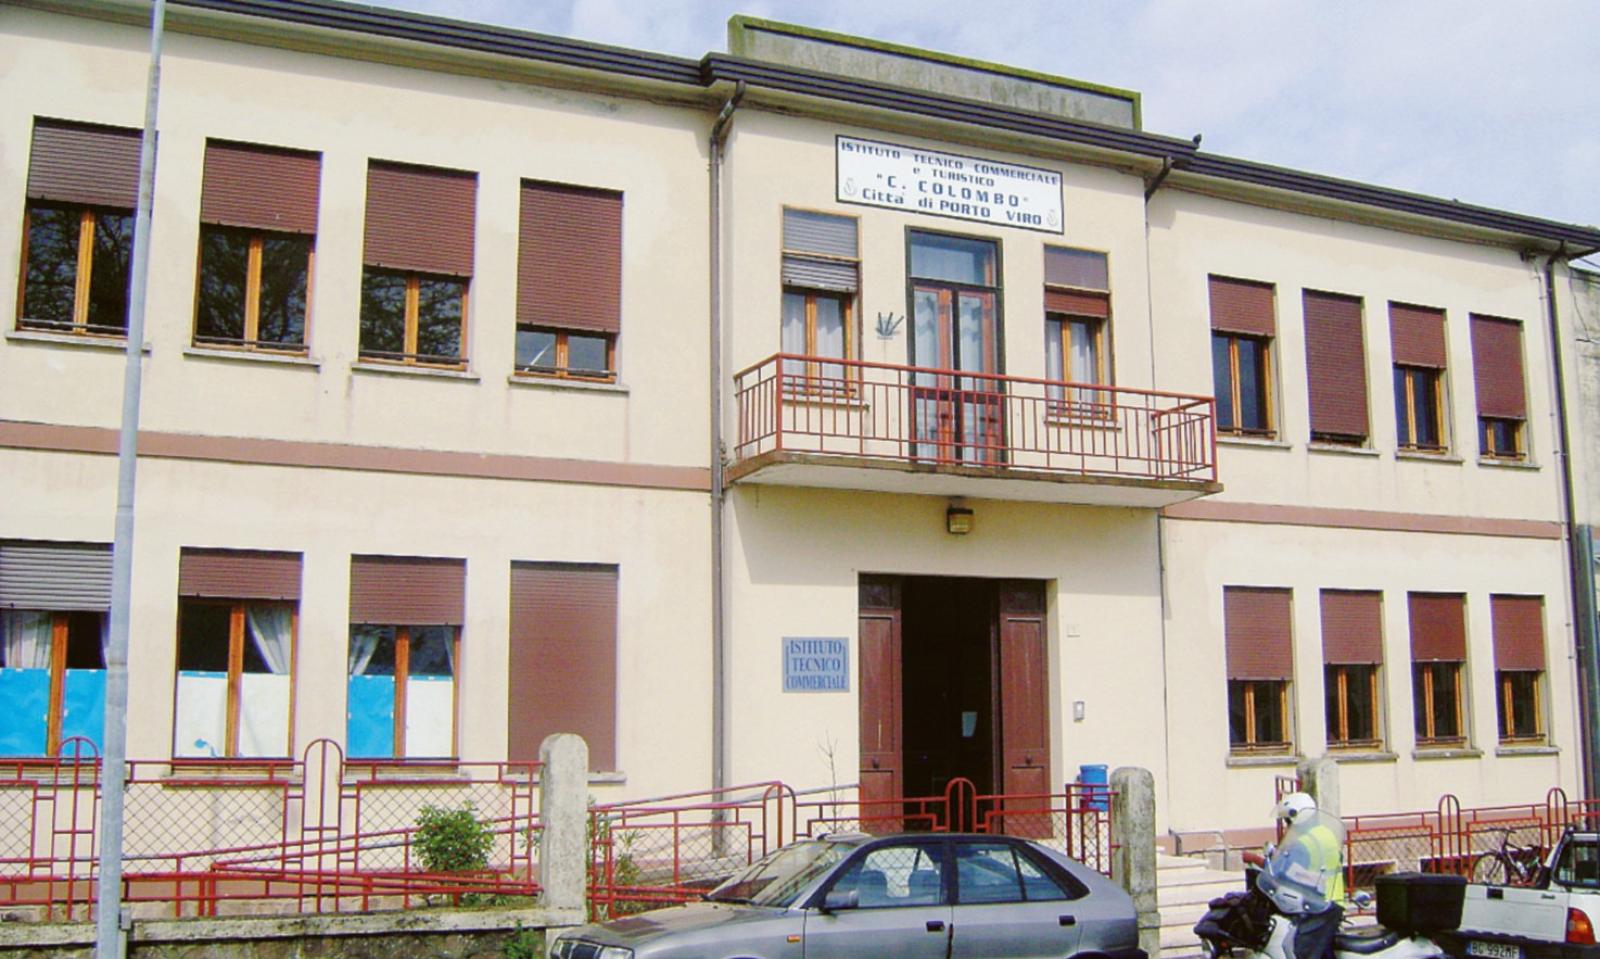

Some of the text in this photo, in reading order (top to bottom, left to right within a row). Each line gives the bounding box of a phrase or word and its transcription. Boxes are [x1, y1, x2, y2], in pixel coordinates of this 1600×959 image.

[841, 141, 1058, 186] ISTITUTO TECNICO COMMERCIALE
[932, 168, 995, 188] TURISTICO
[918, 197, 933, 209] di
[940, 199, 991, 218] PORTO
[1006, 209, 1042, 226] VIRO
[790, 640, 842, 654] ISTITUTO
[792, 657, 841, 672] TECNICO
[786, 675, 846, 689] COMMERCIALE
